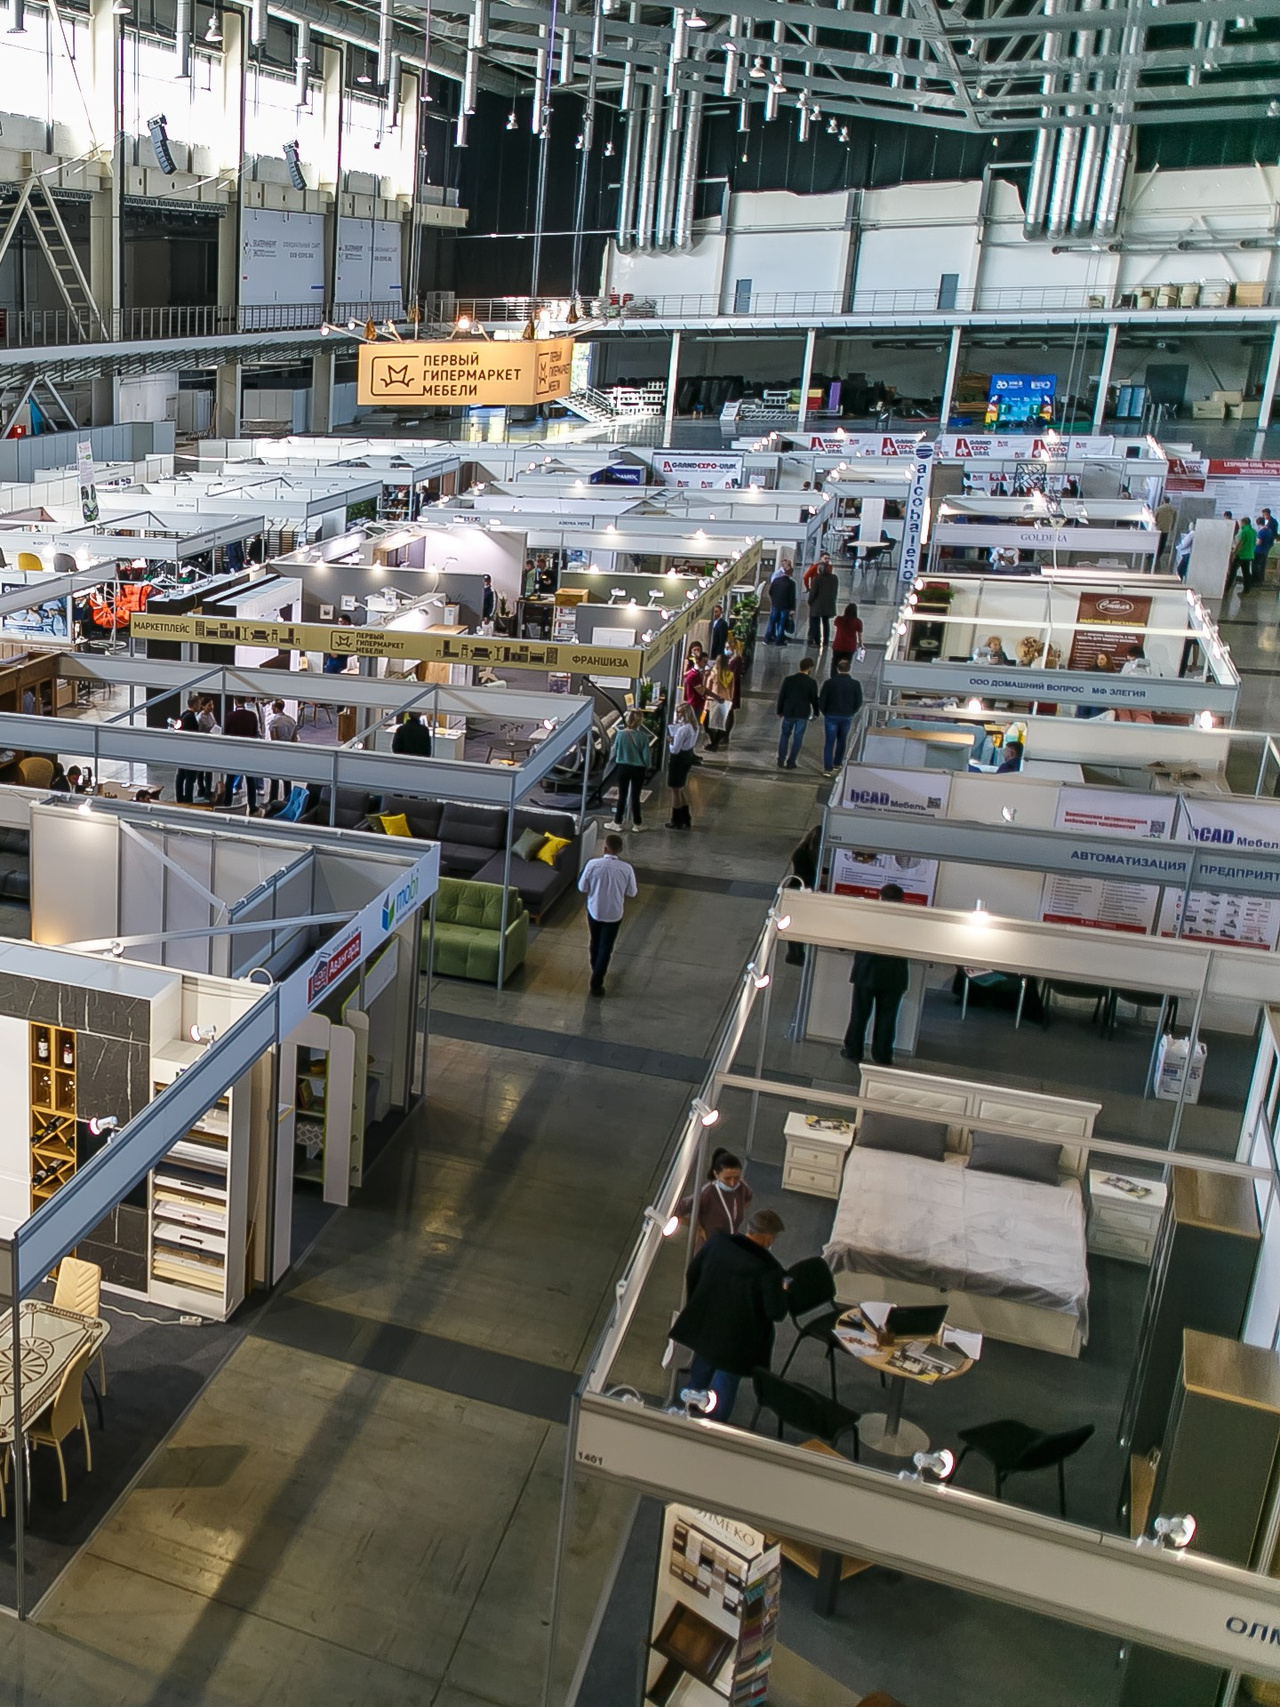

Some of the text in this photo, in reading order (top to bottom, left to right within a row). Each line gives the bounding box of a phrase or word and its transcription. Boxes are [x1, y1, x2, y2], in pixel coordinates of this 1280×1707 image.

[423, 351, 479, 366] ПЕРВЫЙ
[423, 368, 522, 381] ГИПЕРМАРКЕТ
[423, 384, 477, 397] МЕБЕЛИ
[903, 463, 927, 580] arcobaleno
[133, 620, 190, 634] МАРКЕТПЛЕЙС
[356, 632, 384, 641] ПЕРВЫЙ
[356, 639, 404, 650] ГИПЕРМАРКЕТ
[356, 647, 384, 655] МЕБЕЛИ
[572, 654, 629, 668] ФРАНШИЗА
[970, 678, 1146, 697] ООО ДОМАШНИЙ ВОПРОС МФ ЭЛЕГИЯ
[851, 789, 926, 810] bCAD Мебель
[1237, 836, 1280, 849] Мебел
[1071, 850, 1186, 871] АВТОМАТИЗАЦИЯ
[397, 868, 419, 913] mobi
[329, 938, 360, 977] Авангард
[578, 1451, 603, 1465] 1401
[700, 1510, 755, 1547] ЛМЕКО
